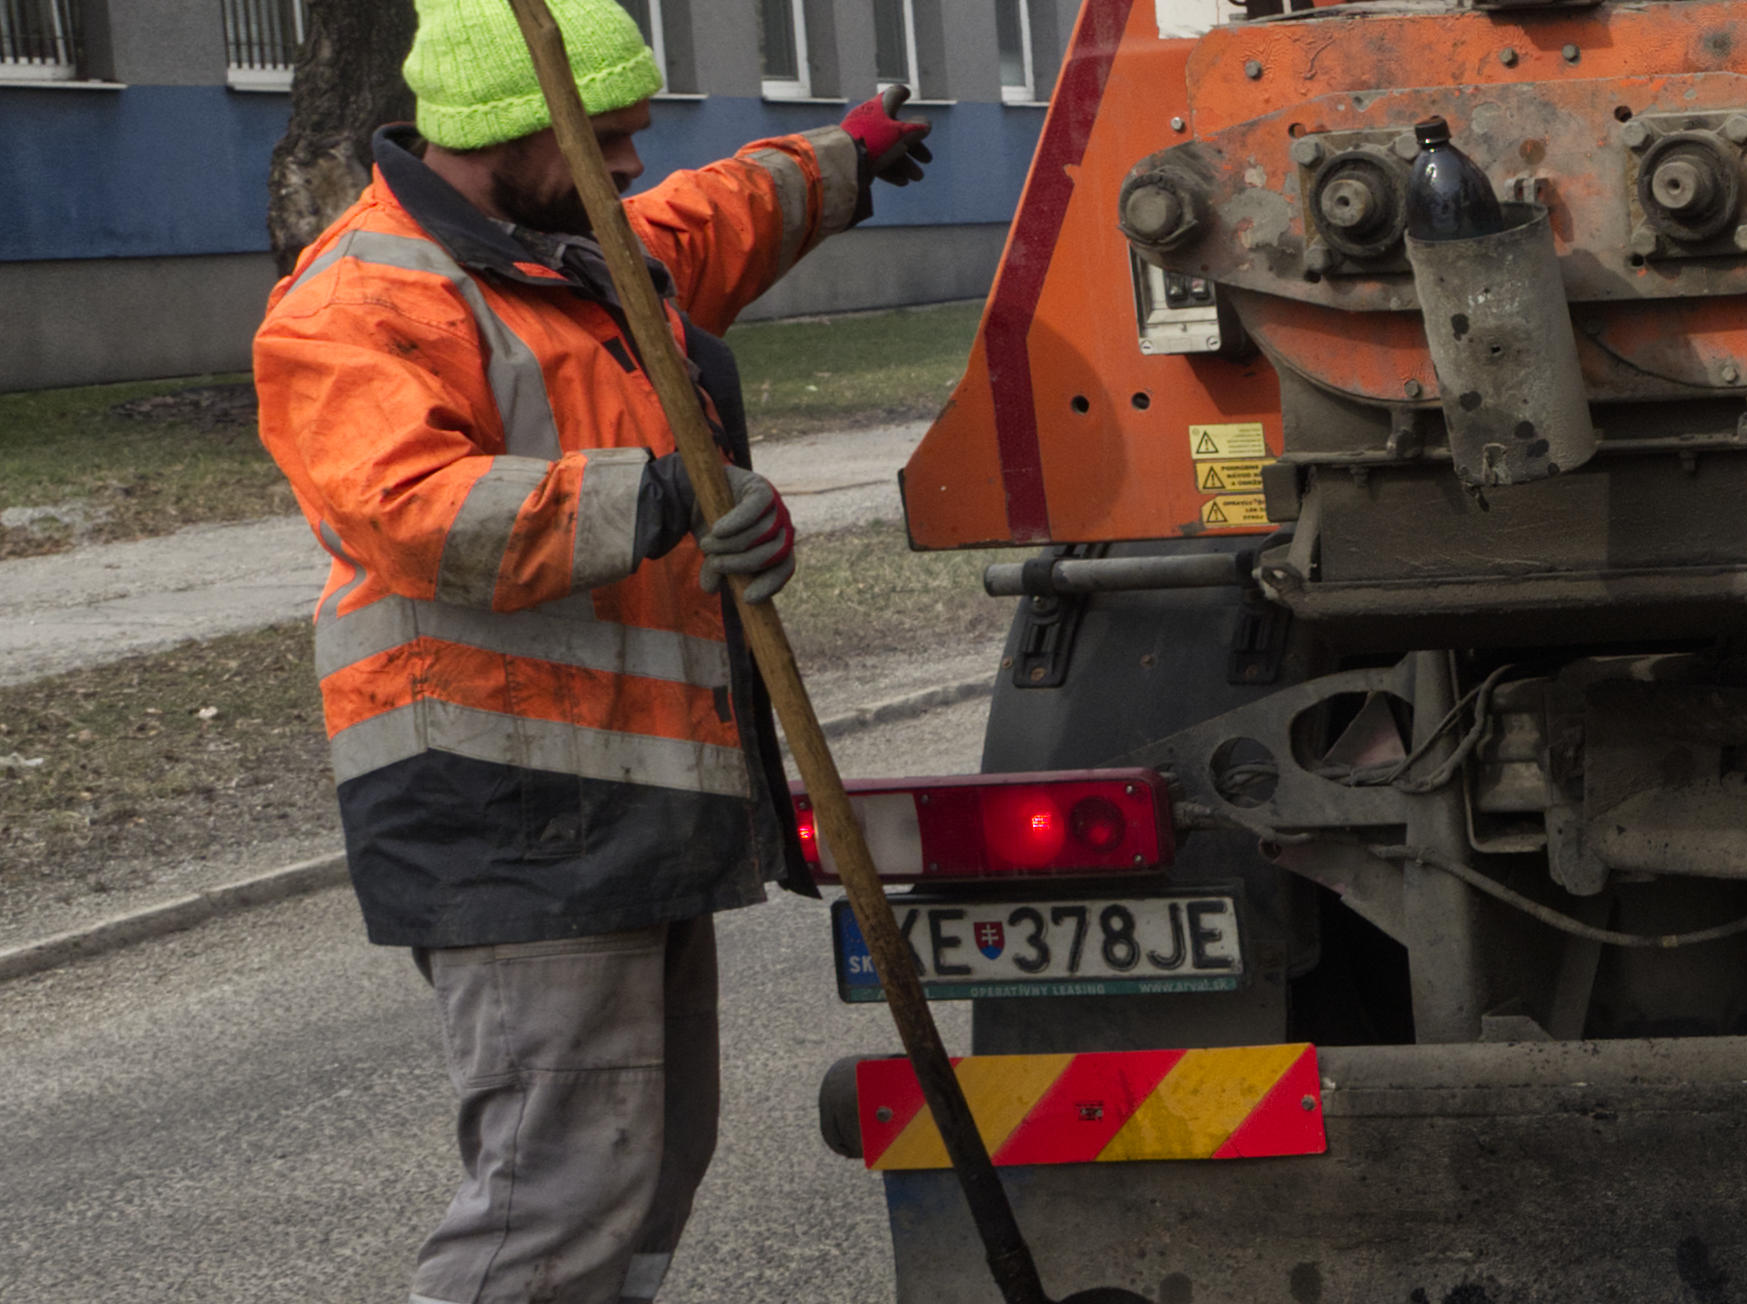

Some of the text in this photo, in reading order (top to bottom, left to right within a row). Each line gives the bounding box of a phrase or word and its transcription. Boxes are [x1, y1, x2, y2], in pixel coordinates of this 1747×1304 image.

[848, 955, 876, 973] SK
[971, 982, 1048, 997] OPERATÍVNY
[1053, 983, 1105, 996] LEASING
